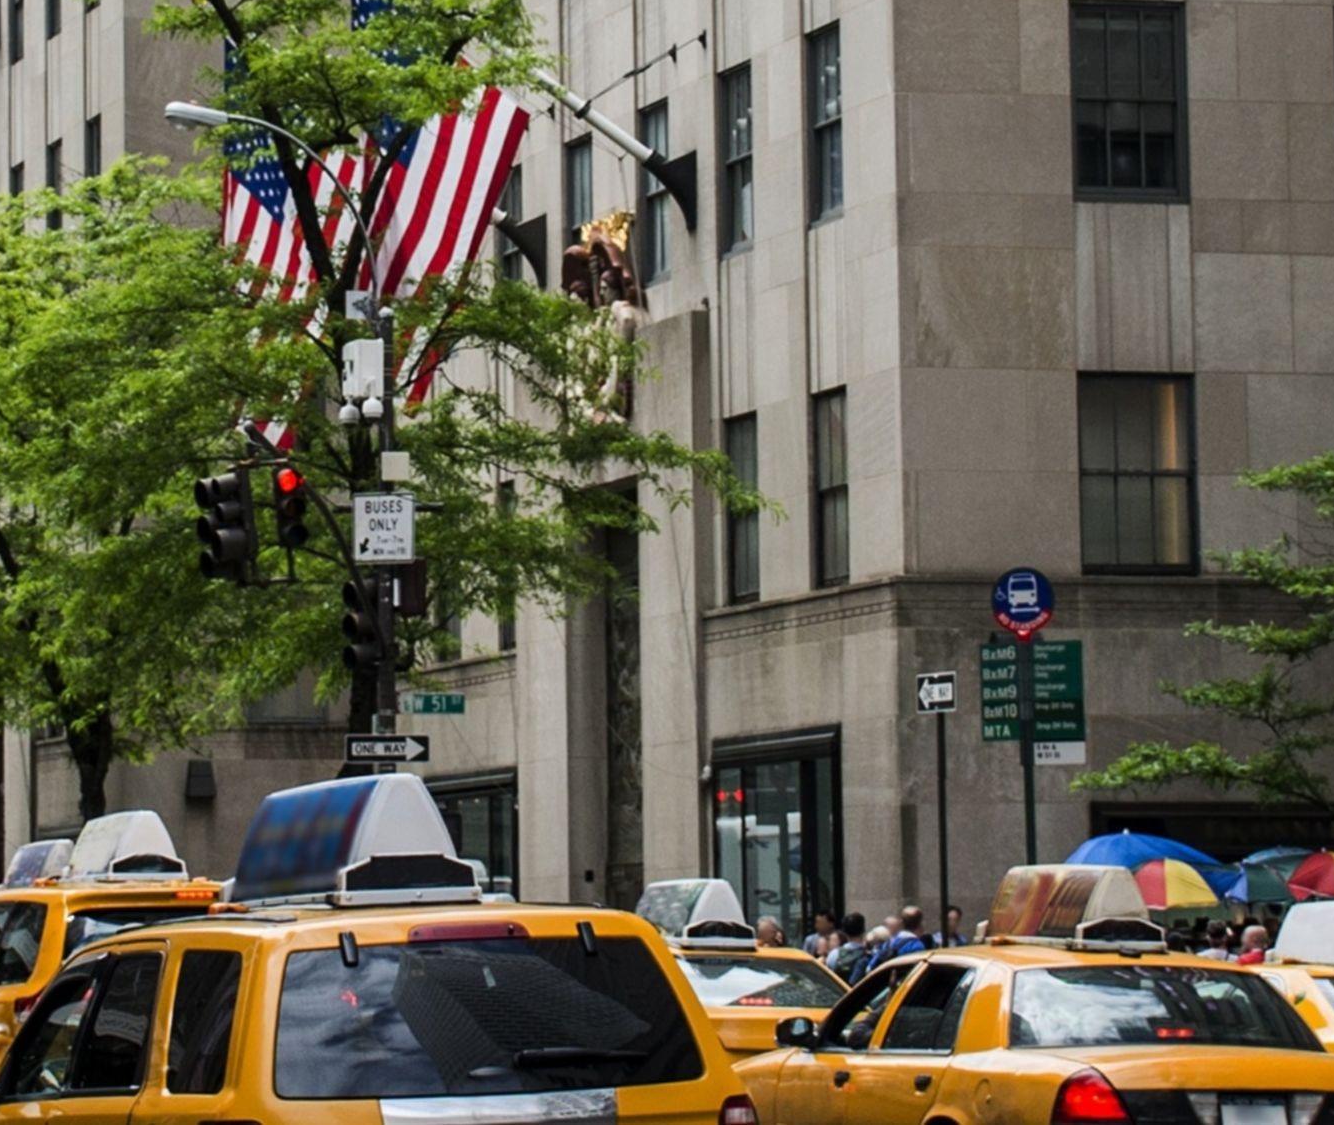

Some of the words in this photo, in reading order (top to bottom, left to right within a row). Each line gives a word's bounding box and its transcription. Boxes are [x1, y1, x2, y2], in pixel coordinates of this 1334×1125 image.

[364, 500, 403, 514] BUSES
[369, 518, 398, 531] ONLY
[982, 645, 1016, 660] BxM6
[982, 665, 1016, 680] BxM7
[983, 684, 1017, 699] BxM9
[414, 696, 424, 712] W
[432, 696, 447, 712] 51
[984, 703, 1017, 718] BxM10
[984, 725, 1011, 737] MTA
[354, 743, 376, 755] ONE
[383, 743, 406, 755] WAY
